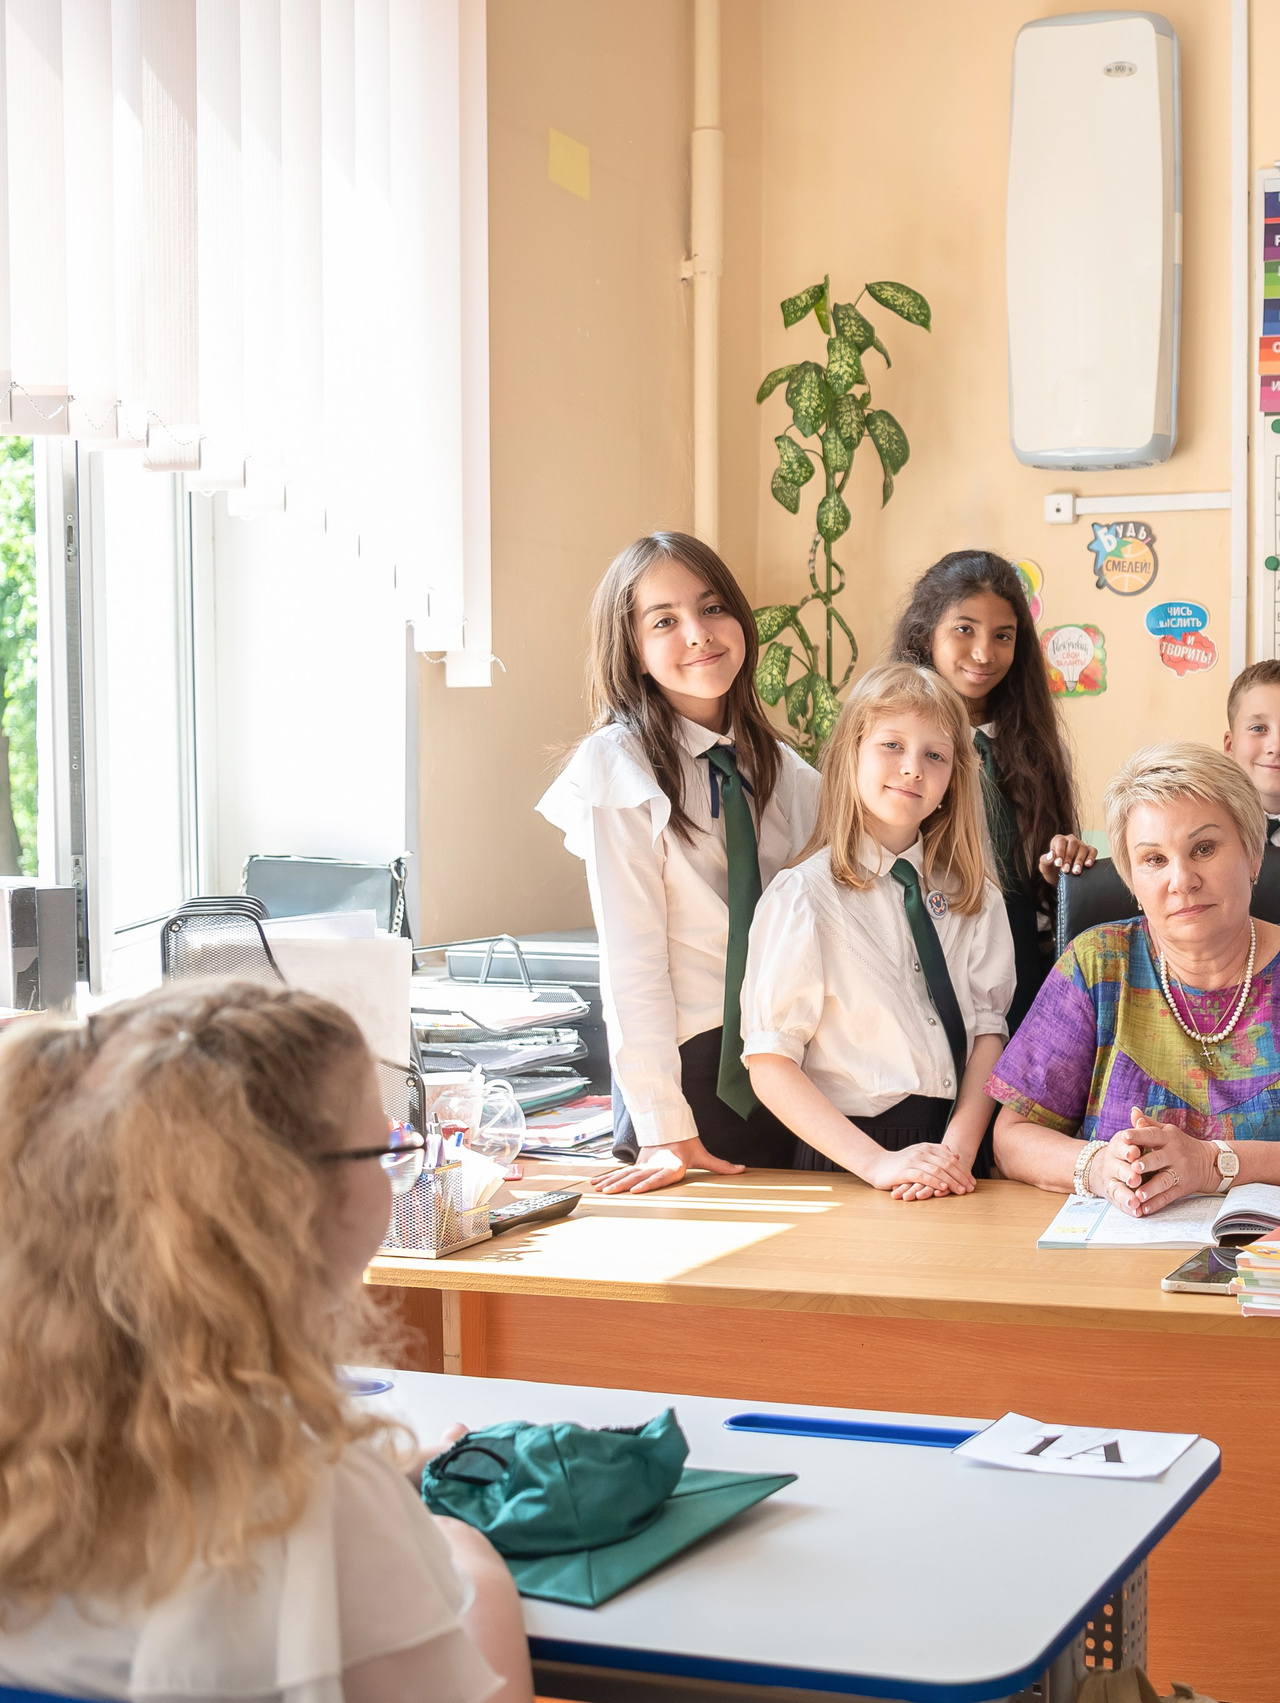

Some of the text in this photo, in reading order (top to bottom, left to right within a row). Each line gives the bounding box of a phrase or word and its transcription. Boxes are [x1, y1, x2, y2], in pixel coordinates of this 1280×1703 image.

[1106, 560, 1151, 574] СМЕЛЕЙ!
[1168, 607, 1192, 616] ЧИСЬ
[1187, 636, 1195, 645] И
[1162, 642, 1212, 664] ТВОРИТЬ!
